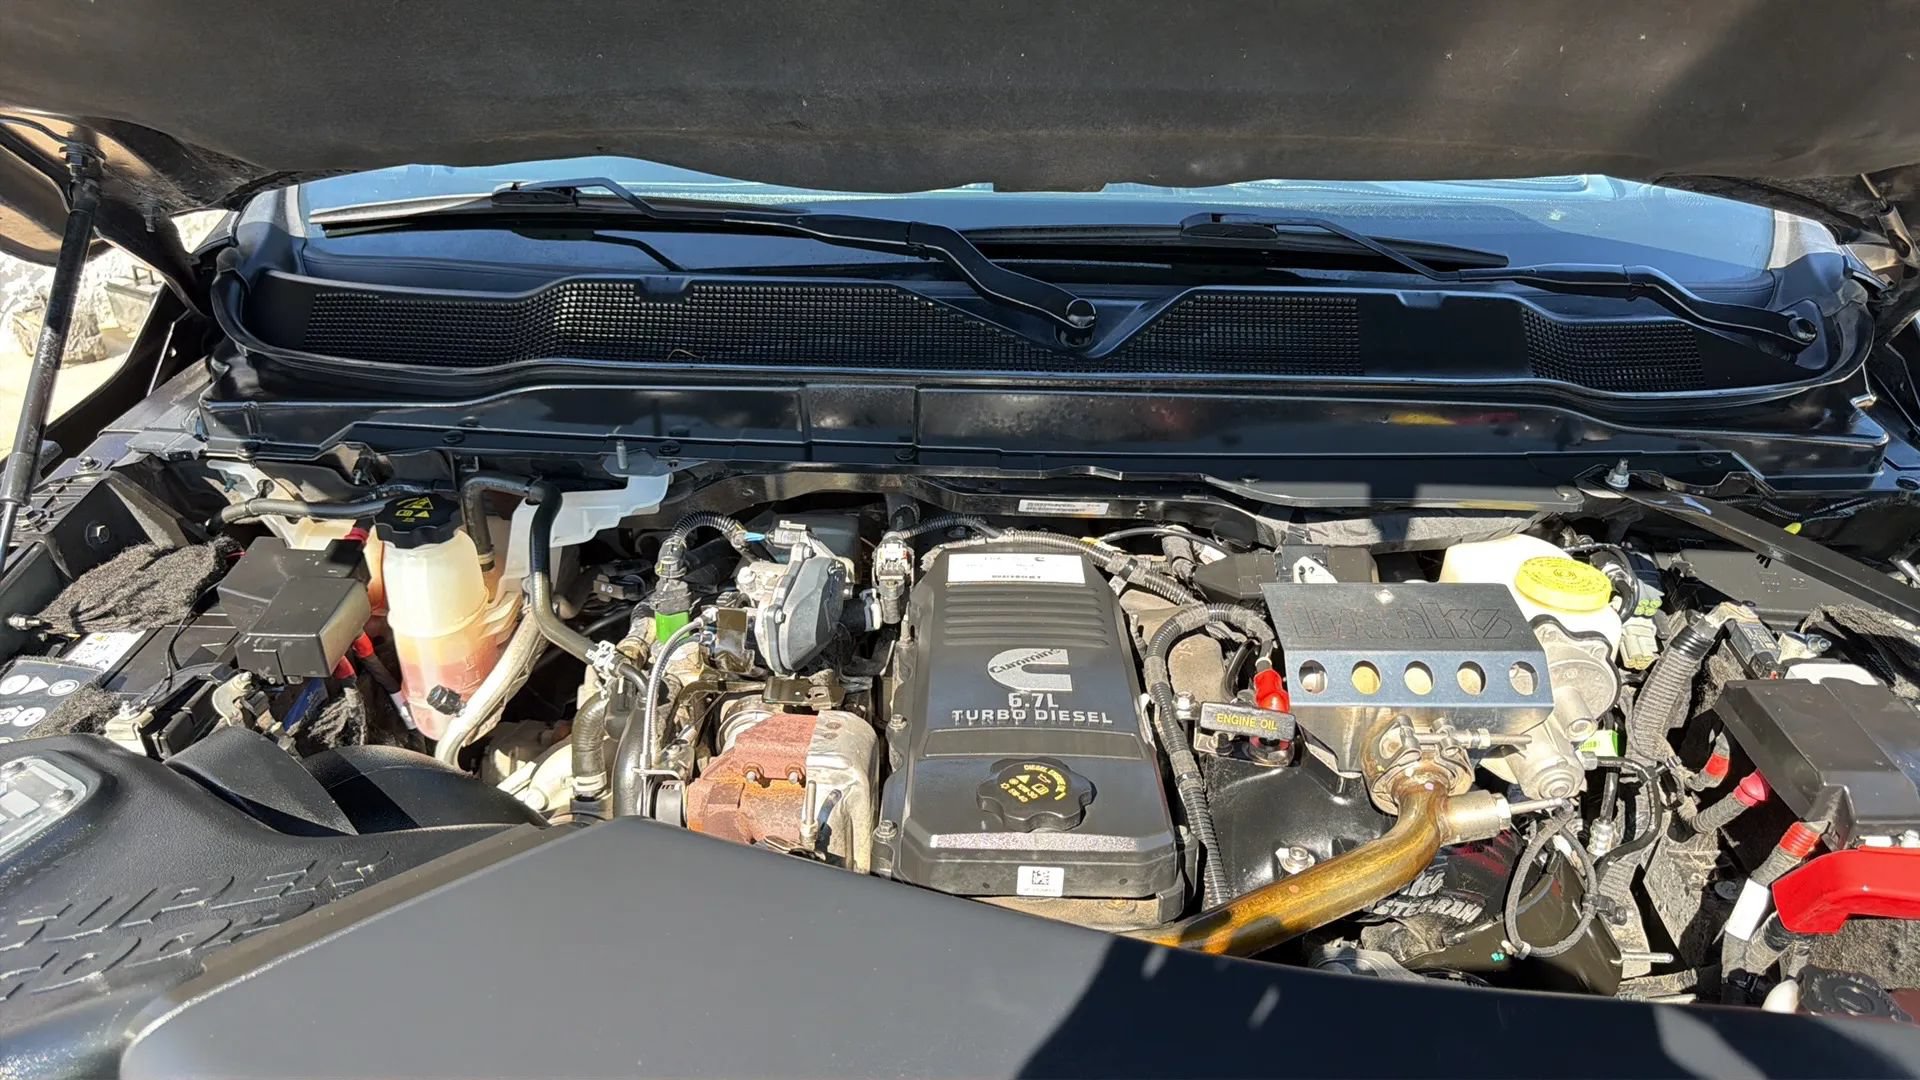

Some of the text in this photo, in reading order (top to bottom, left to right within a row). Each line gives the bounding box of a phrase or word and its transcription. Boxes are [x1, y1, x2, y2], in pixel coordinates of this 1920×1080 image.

[1008, 692, 1059, 708] 6.7L
[952, 709, 1113, 724] TURBO DIESEL
[1215, 713, 1278, 730] ENGINE OIL
